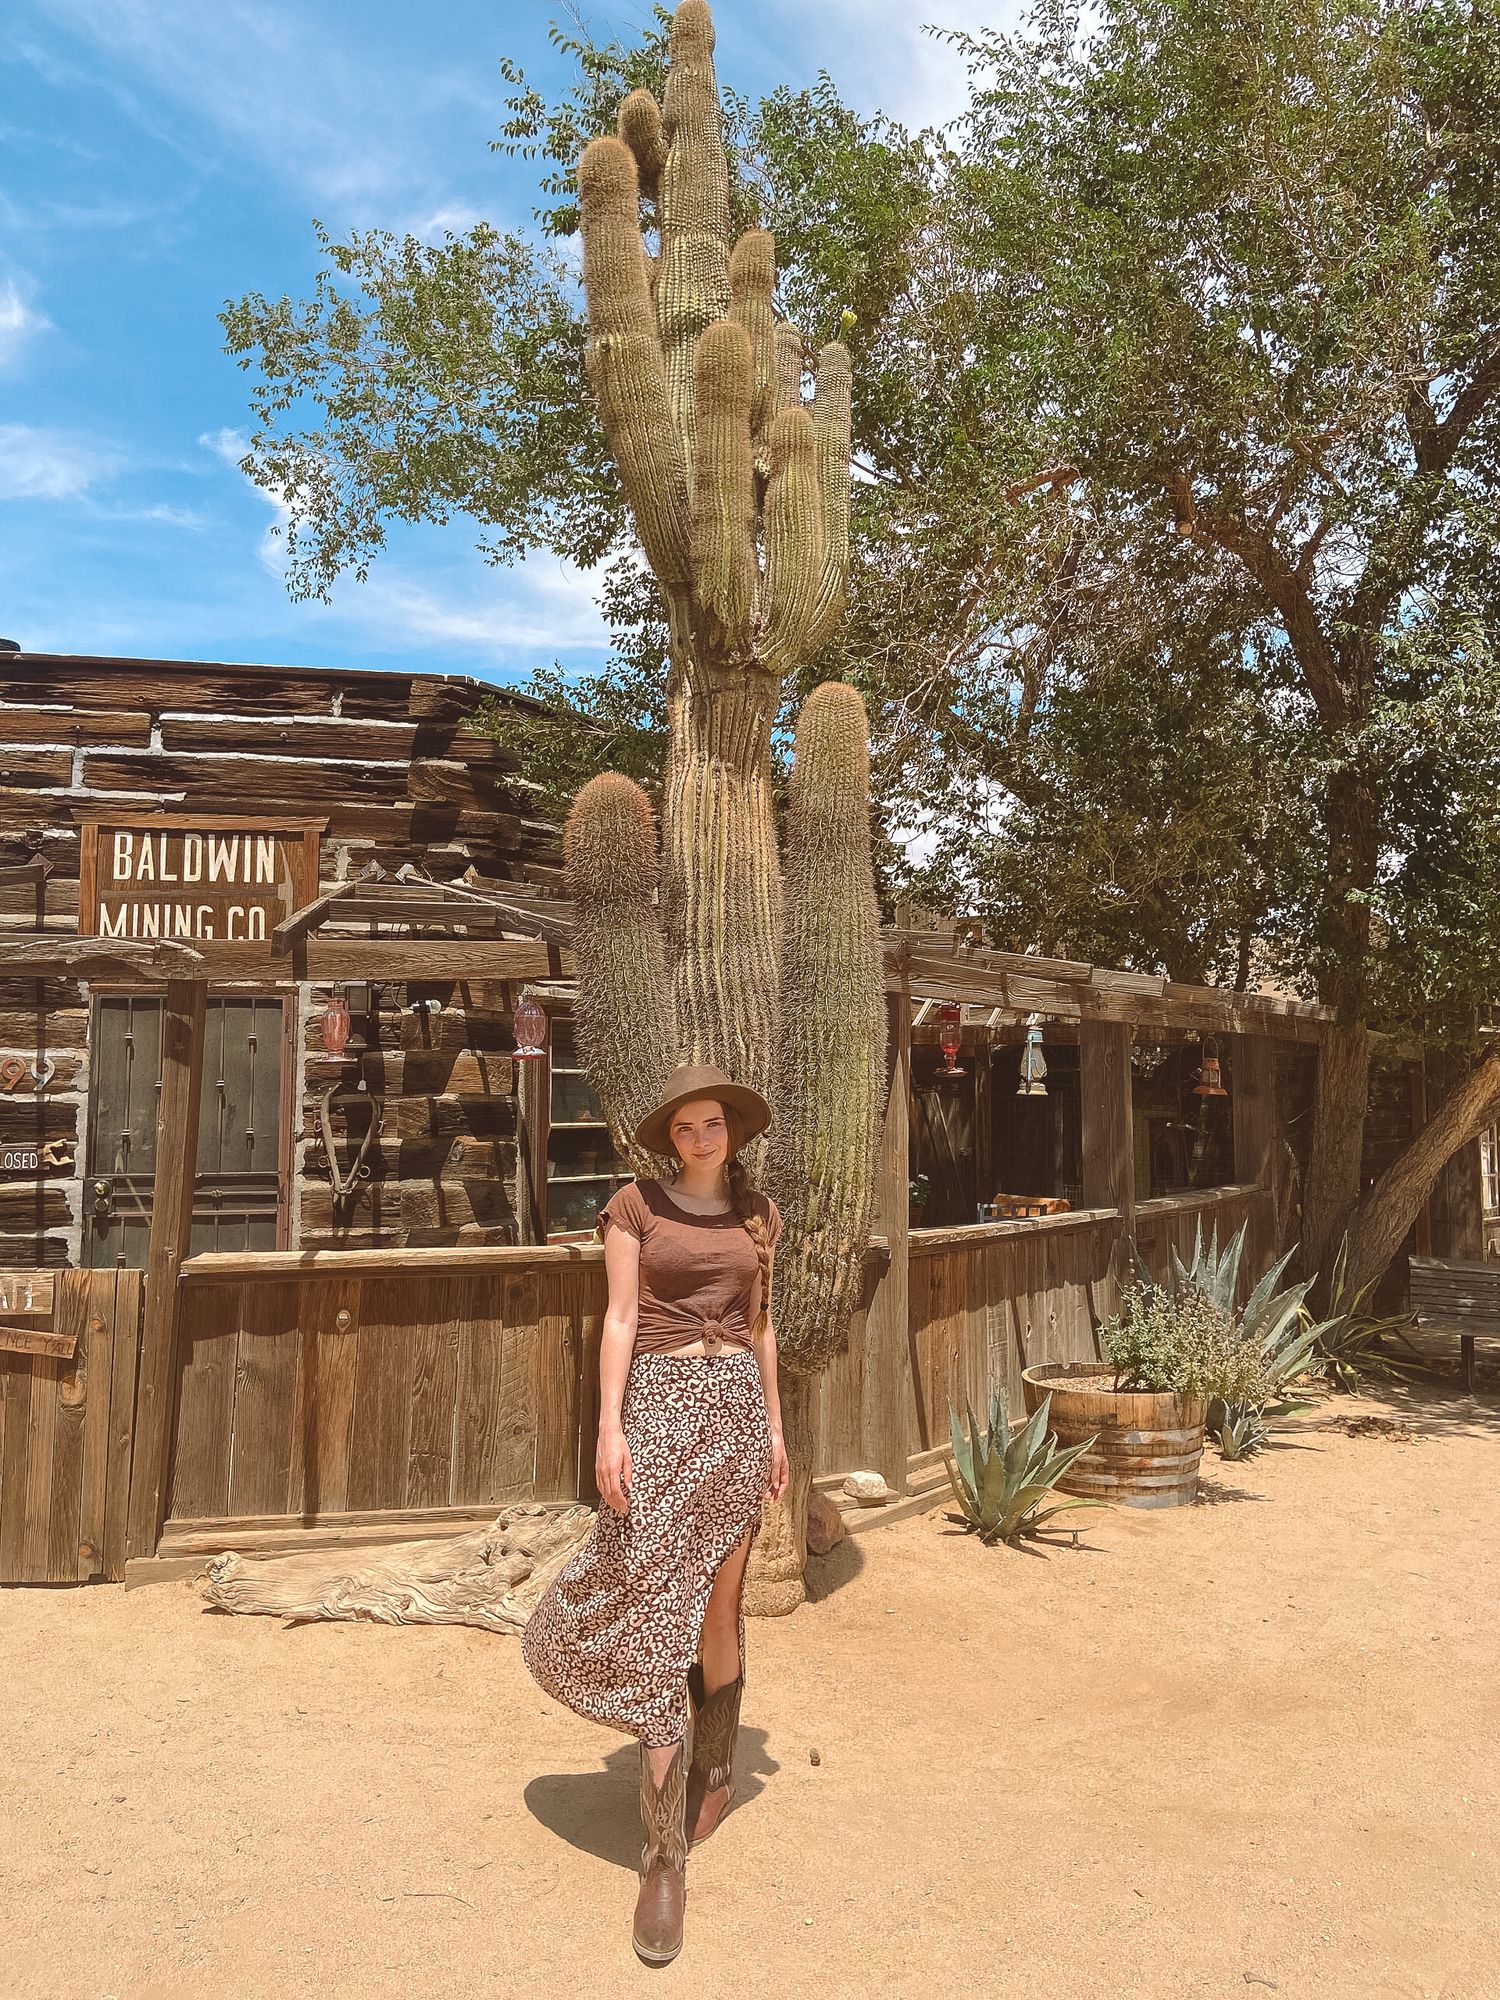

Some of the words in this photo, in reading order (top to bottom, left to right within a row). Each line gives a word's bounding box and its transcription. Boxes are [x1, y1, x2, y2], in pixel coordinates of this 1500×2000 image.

[112, 831, 275, 884] BALDWIN
[100, 902, 215, 941] MINING
[227, 905, 266, 941] CO
